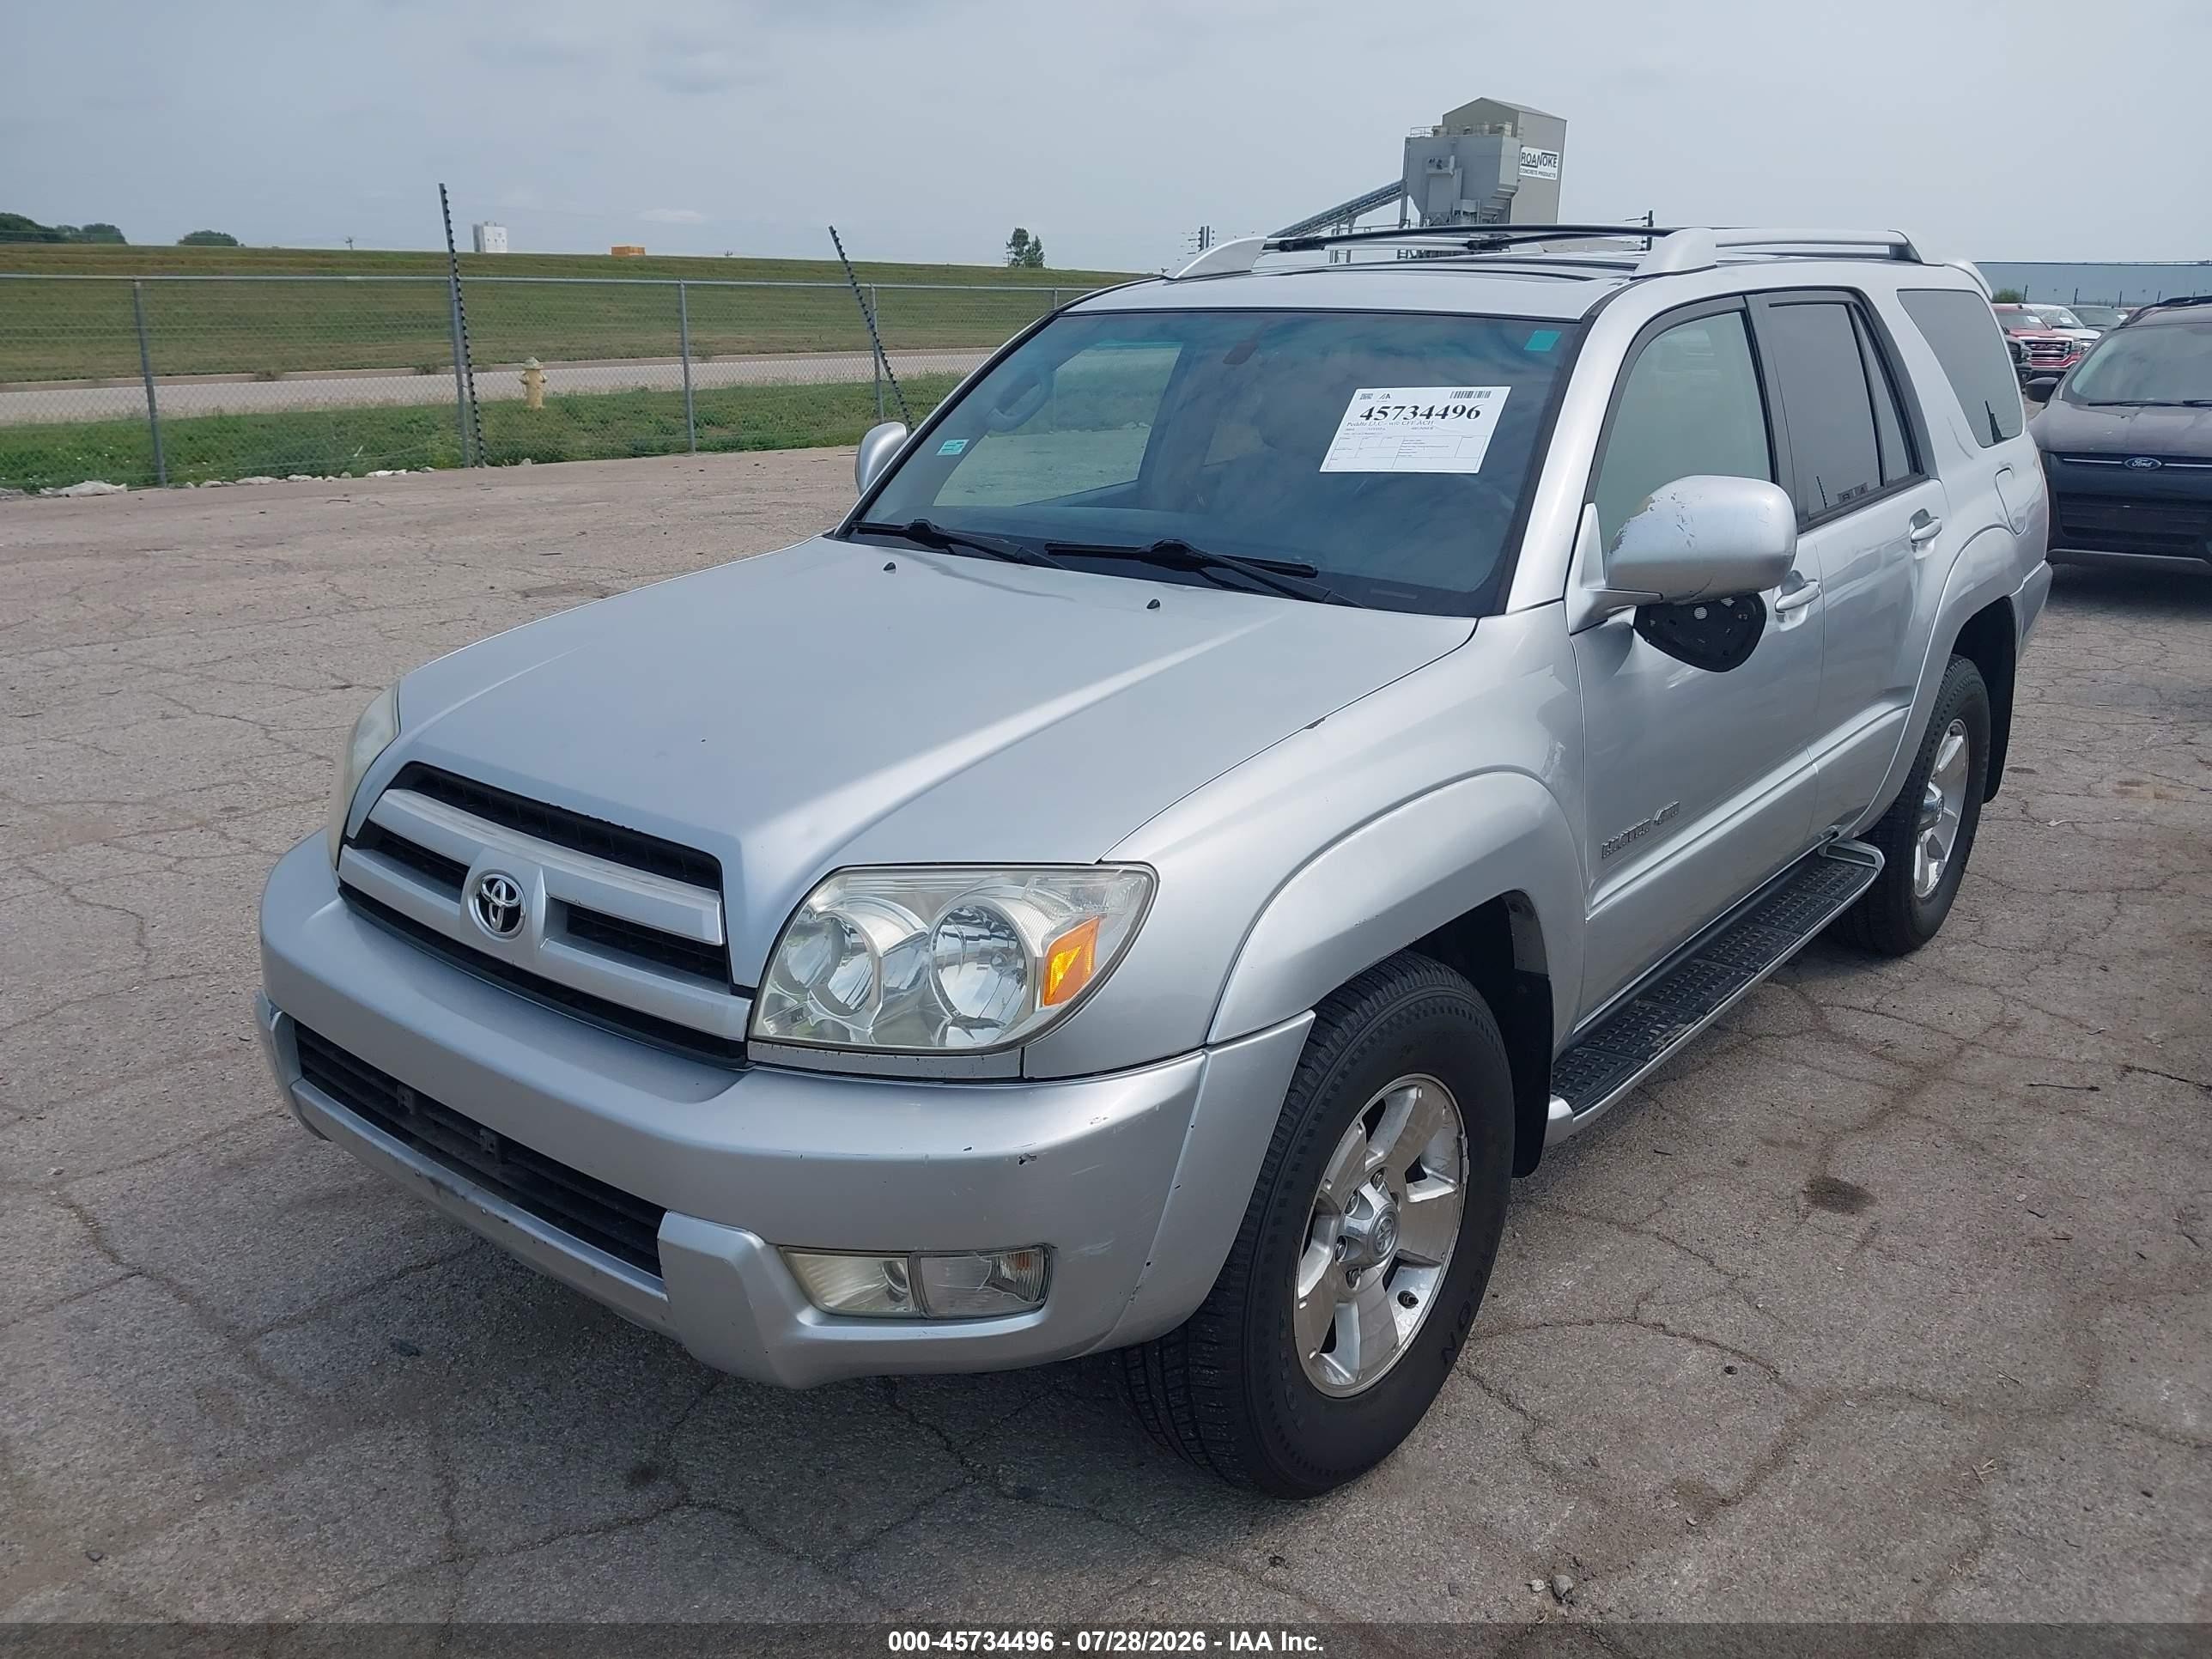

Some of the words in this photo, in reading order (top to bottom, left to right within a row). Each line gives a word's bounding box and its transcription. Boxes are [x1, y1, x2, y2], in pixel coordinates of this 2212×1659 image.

[1522, 152, 1558, 168] ROANOKE
[1359, 404, 1485, 421] 45734496
[2131, 459, 2153, 469] Ford
